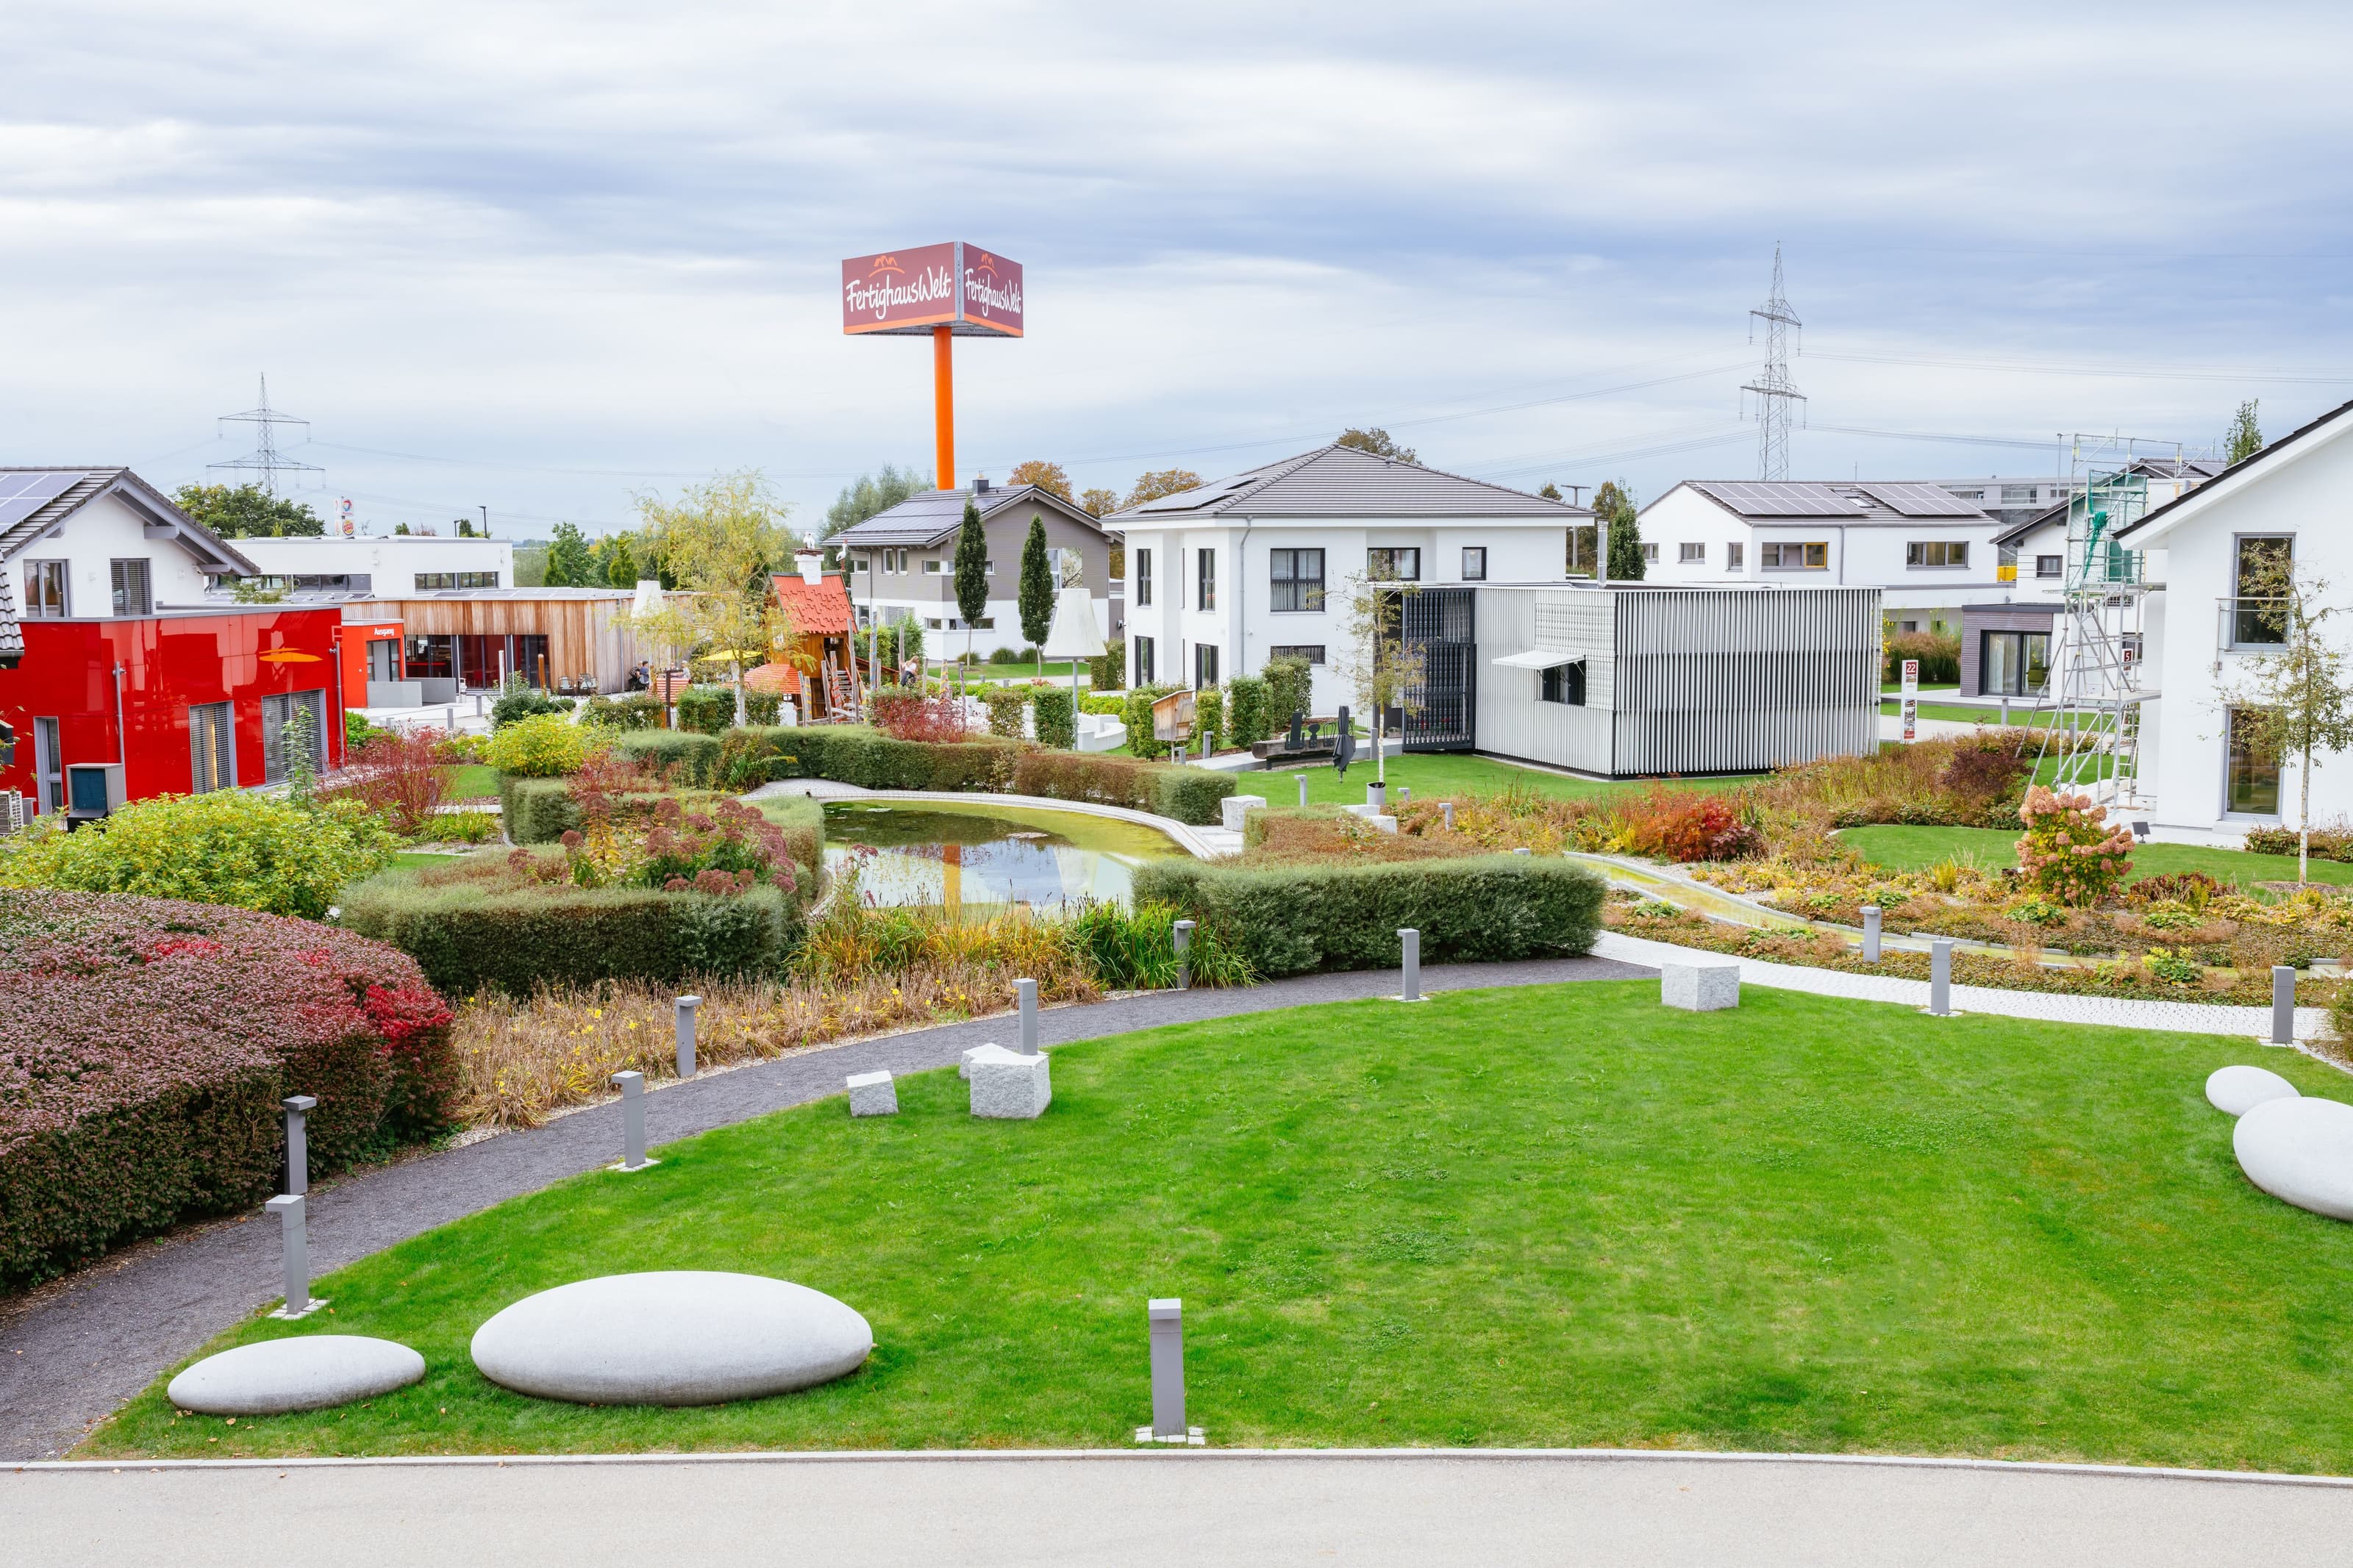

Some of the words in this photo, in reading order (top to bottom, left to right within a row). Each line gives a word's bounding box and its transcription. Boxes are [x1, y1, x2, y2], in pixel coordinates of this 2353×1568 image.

[846, 265, 951, 320] FertighausWelt
[965, 268, 1021, 317] FertighausWelt
[374, 627, 395, 637] Ausgang
[2126, 652, 2129, 661] 5
[1907, 664, 1915, 673] 22
